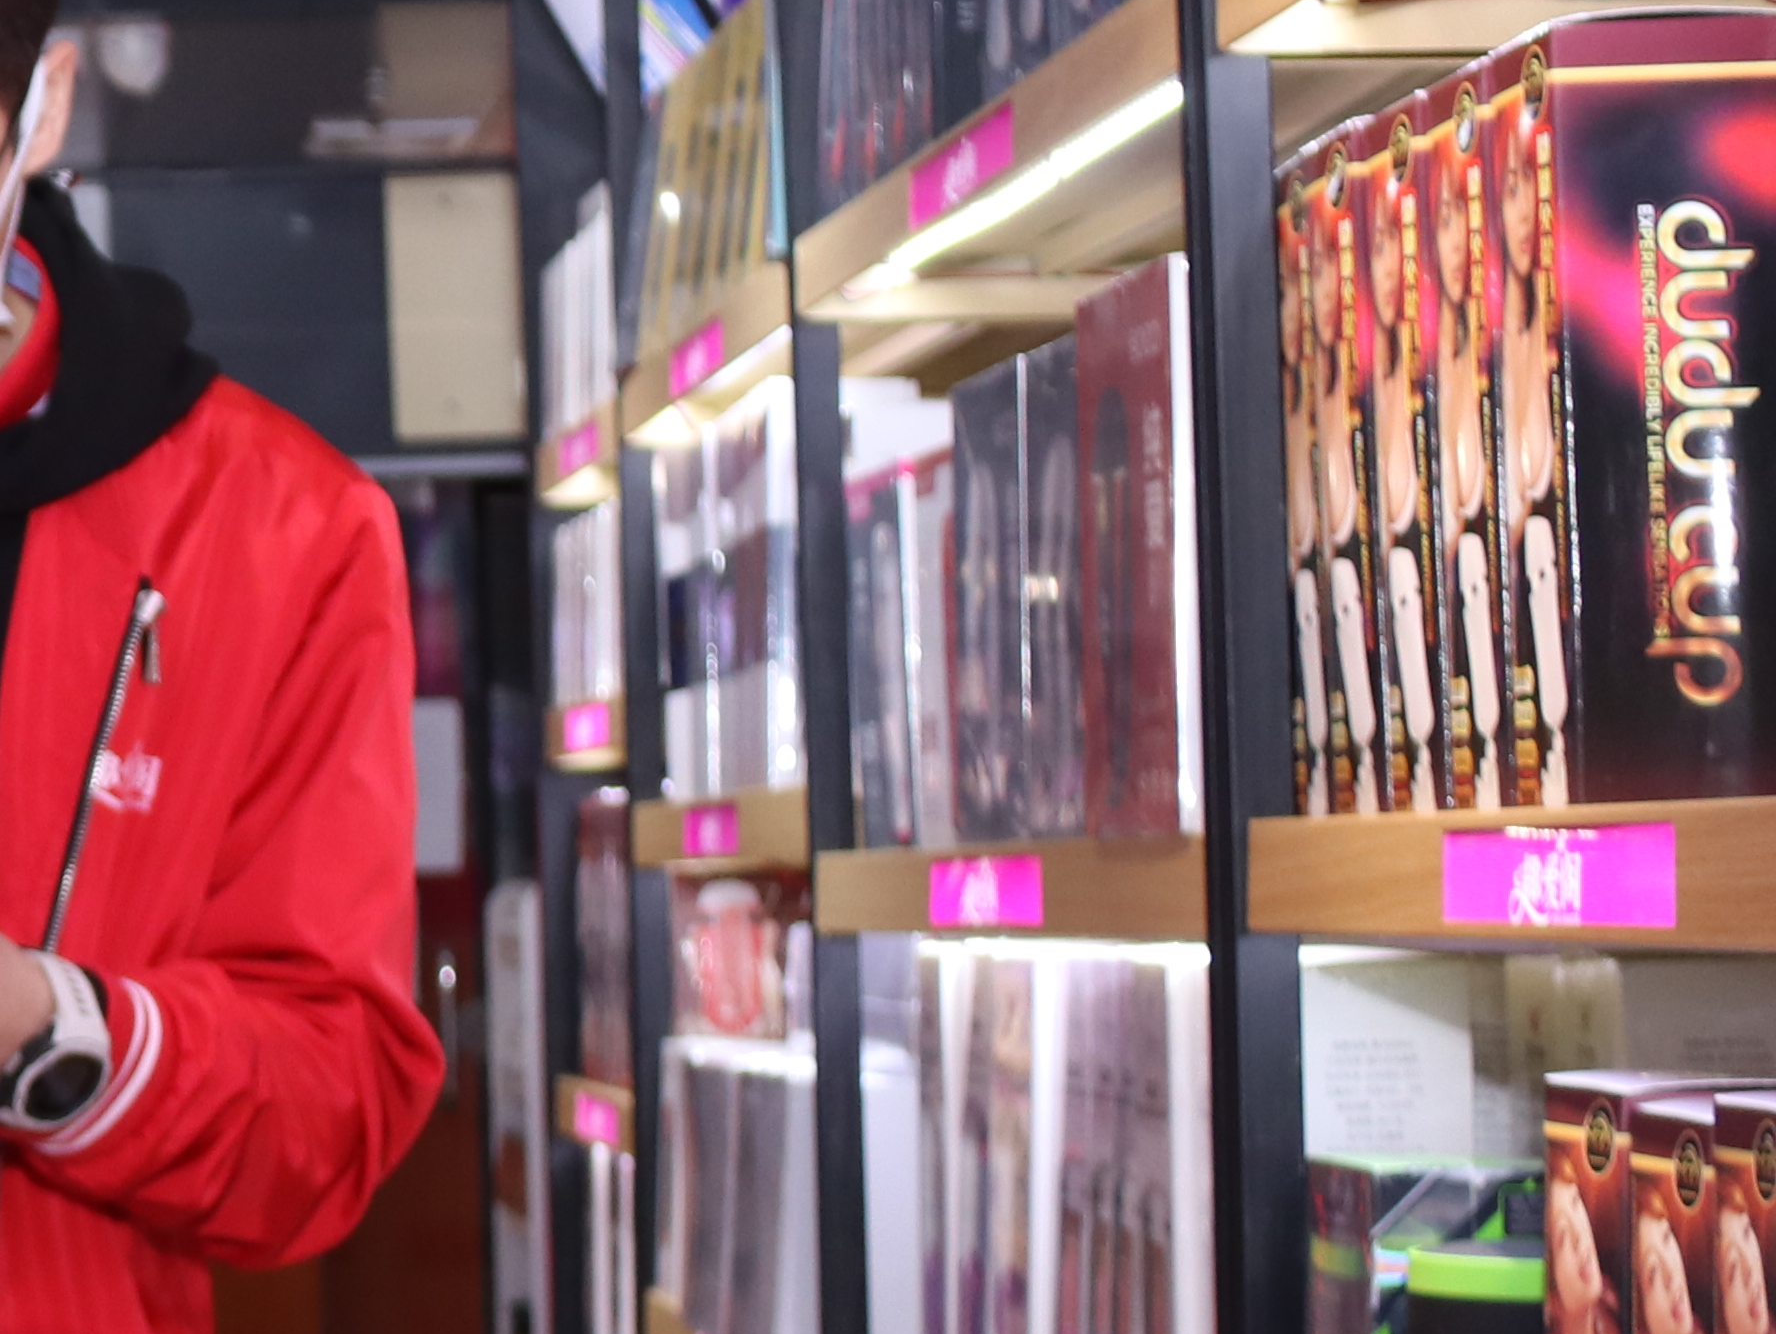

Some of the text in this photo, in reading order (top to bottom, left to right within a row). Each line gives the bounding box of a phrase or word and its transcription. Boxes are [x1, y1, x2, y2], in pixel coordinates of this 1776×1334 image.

[1636, 202, 1657, 318] EXPERIENCE
[1642, 320, 1665, 422] INCREDIBLY
[1645, 199, 1761, 708] dudu cup
[1646, 424, 1668, 513] LIFELIKE
